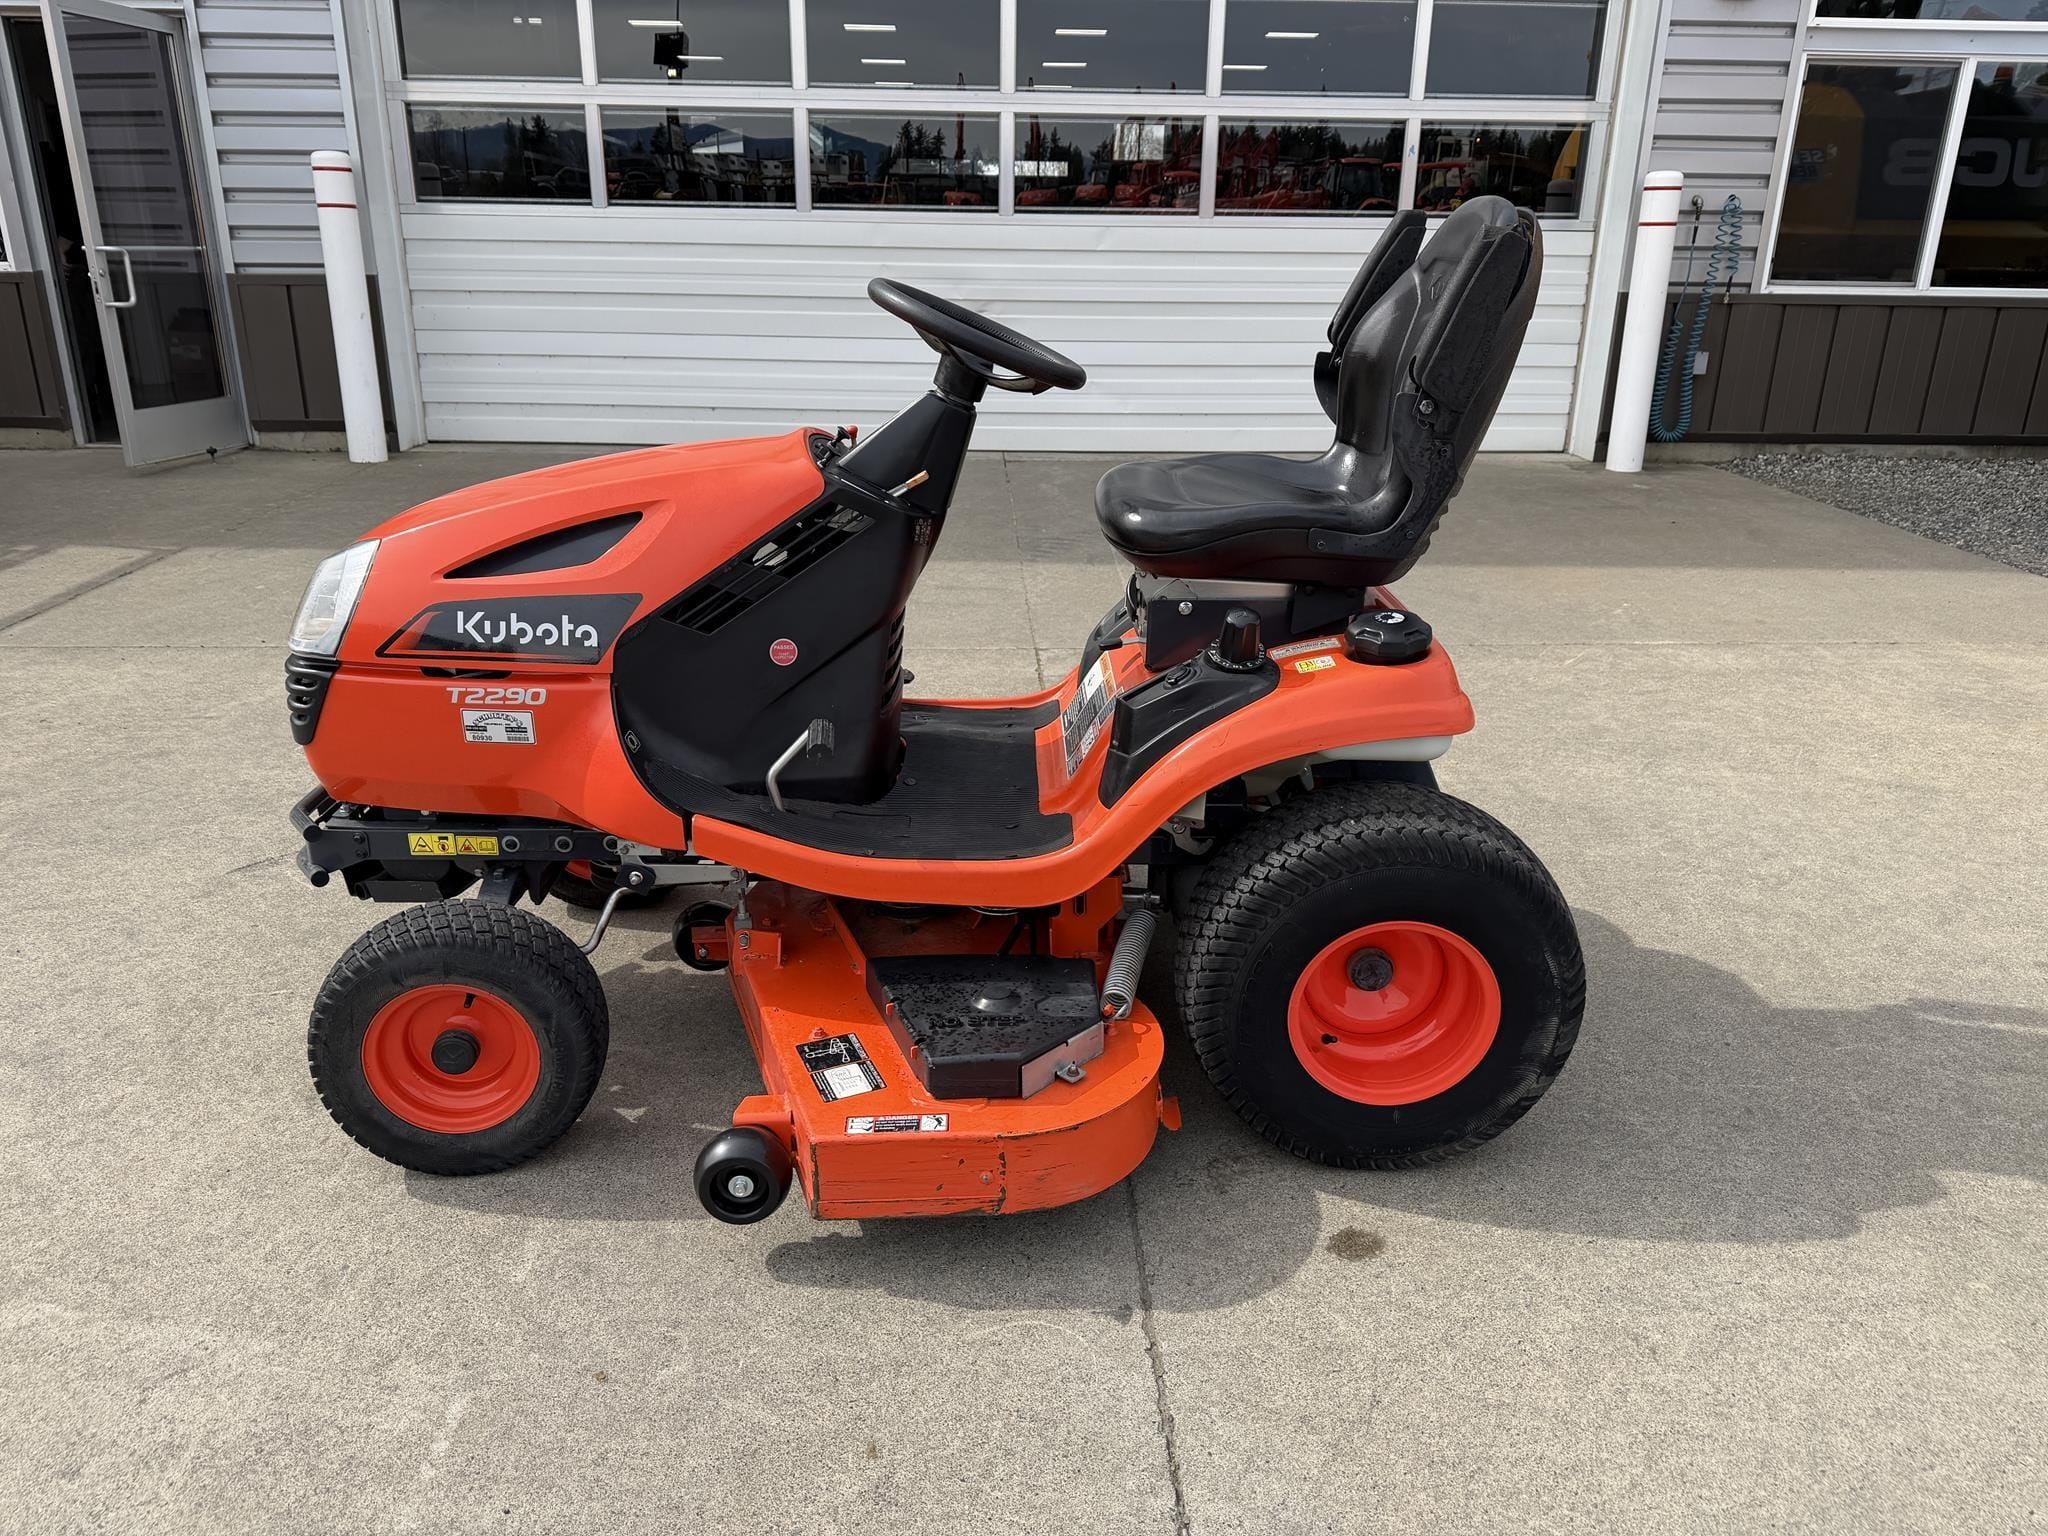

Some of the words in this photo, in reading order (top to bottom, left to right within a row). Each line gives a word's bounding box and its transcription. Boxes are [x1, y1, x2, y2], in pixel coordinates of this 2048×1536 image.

[456, 610, 599, 648] Kubota
[446, 687, 548, 706] T2290
[966, 1012, 1026, 1030] STEP
